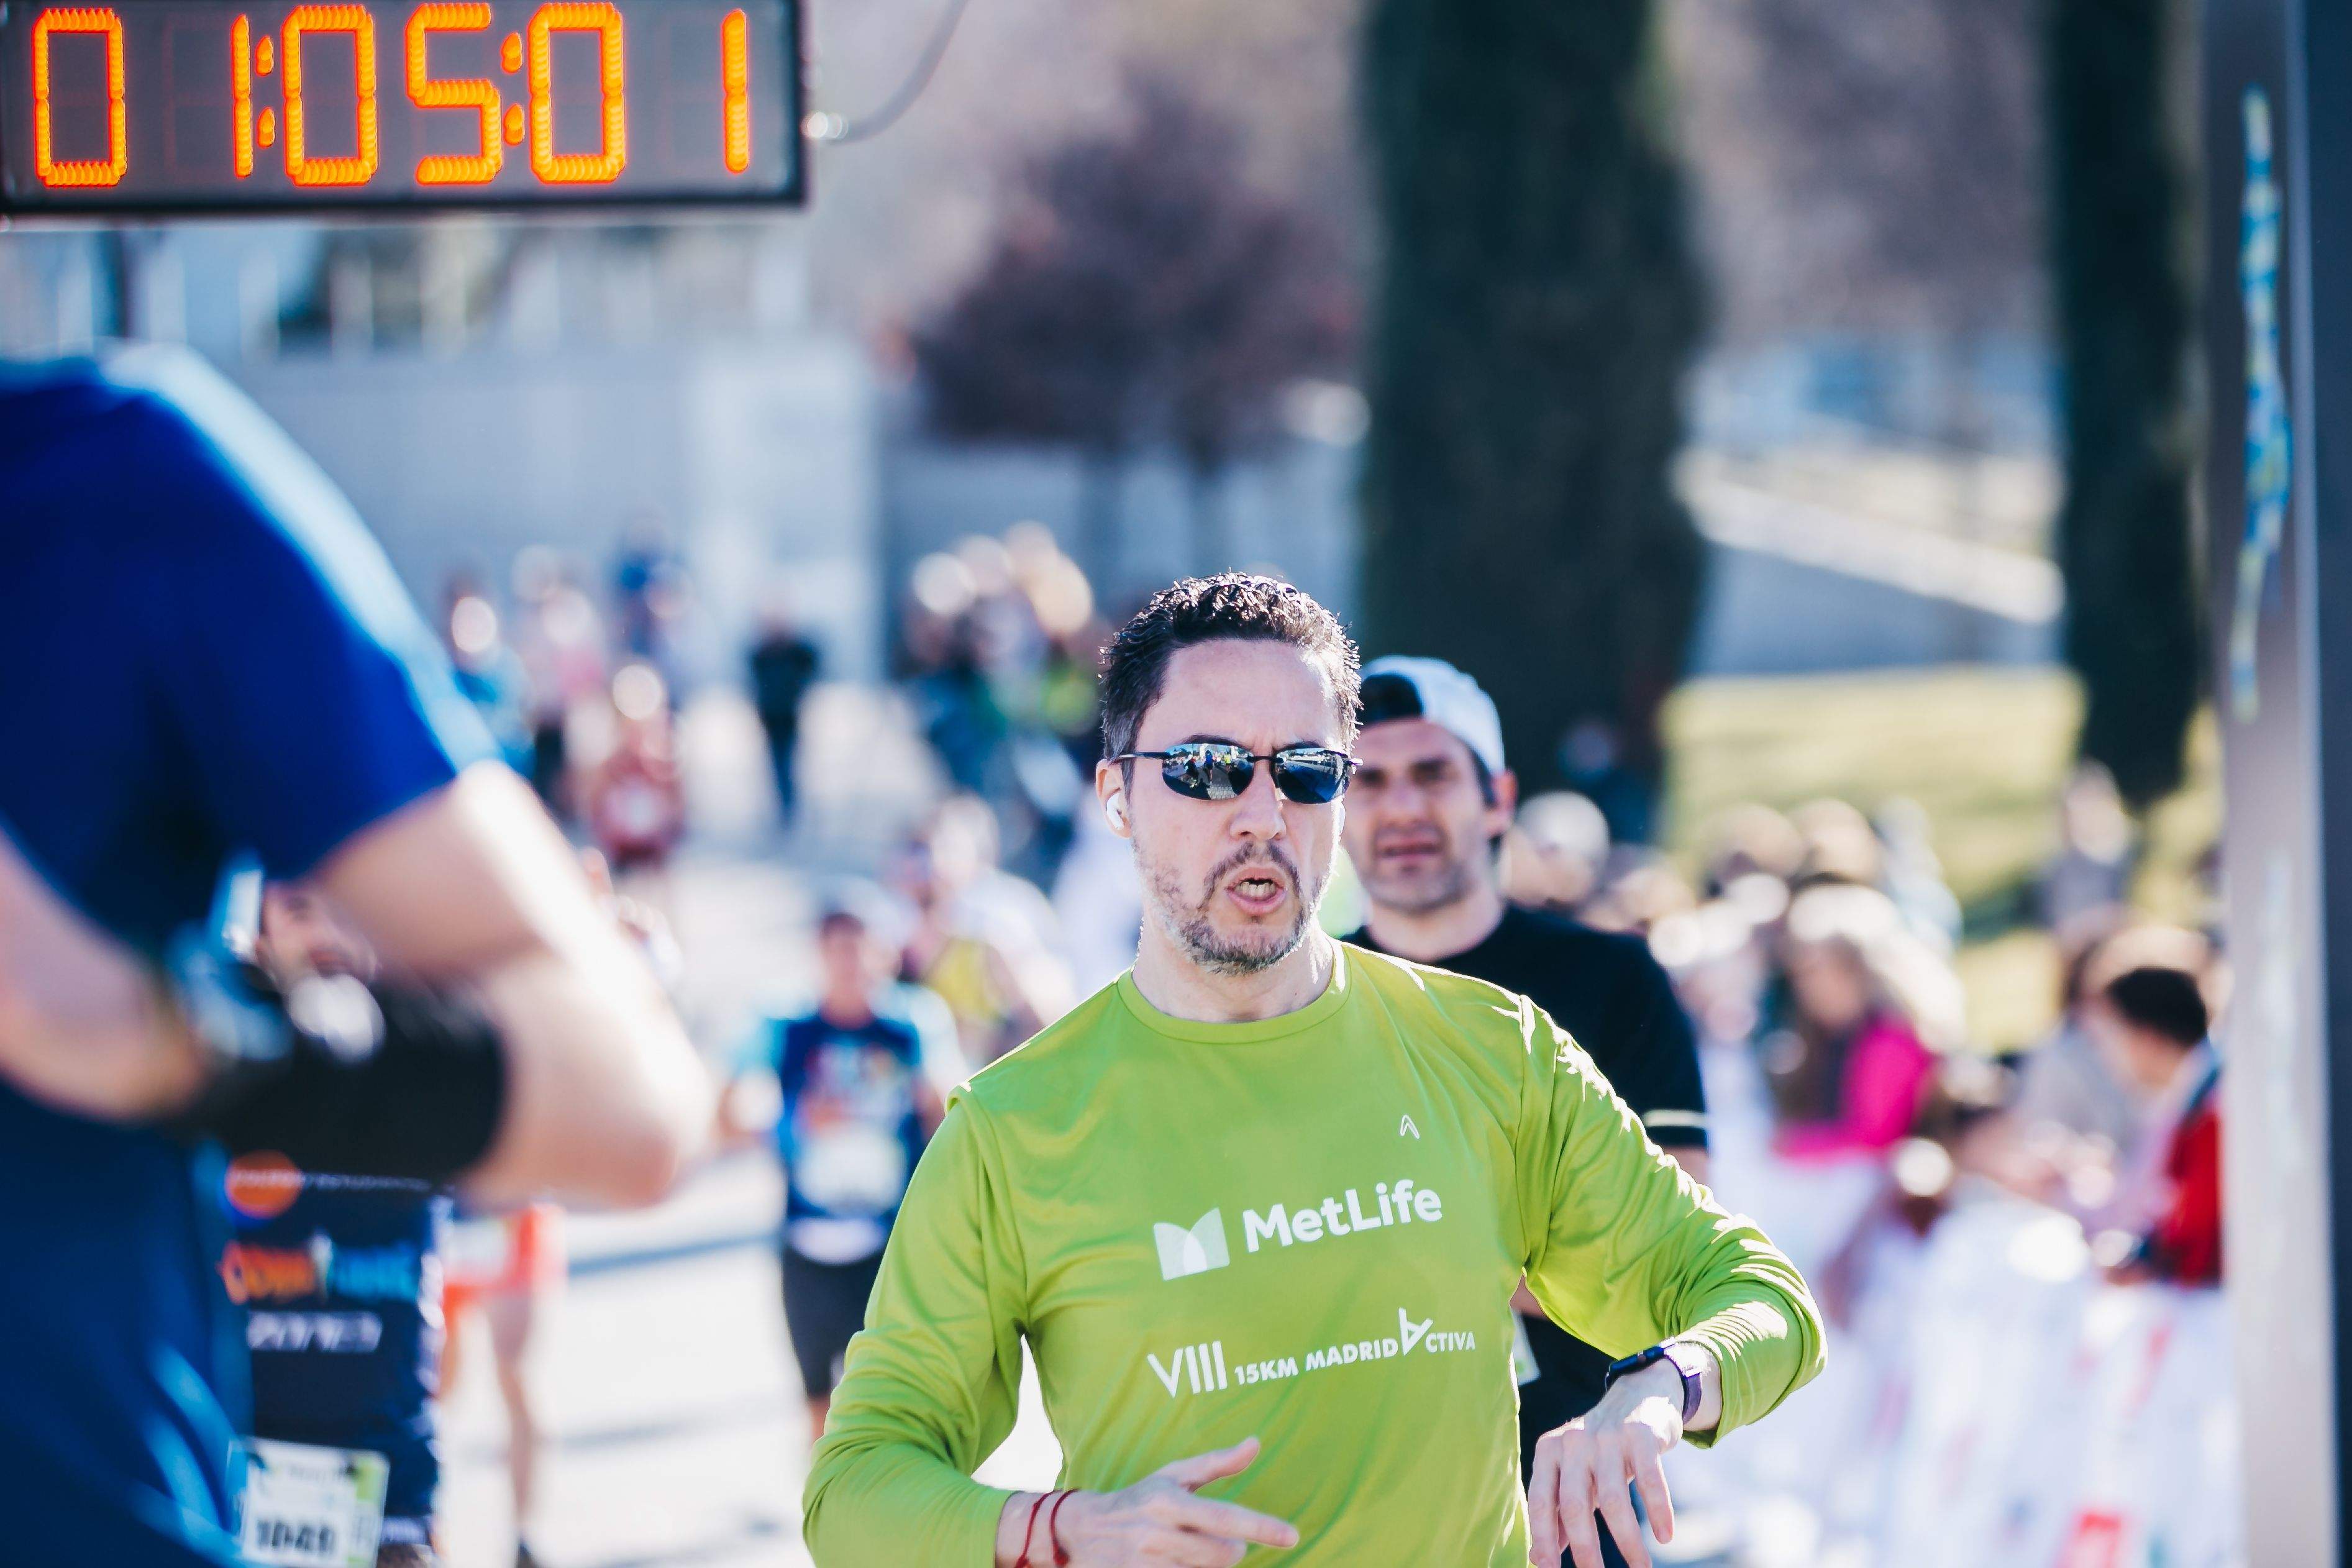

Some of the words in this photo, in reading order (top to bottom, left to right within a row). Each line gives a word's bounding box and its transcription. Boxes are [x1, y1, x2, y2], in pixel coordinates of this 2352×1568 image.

[1242, 1180, 1443, 1252] MetLife
[1147, 1341, 1228, 1398] VIII
[1234, 1357, 1298, 1385] 15KM
